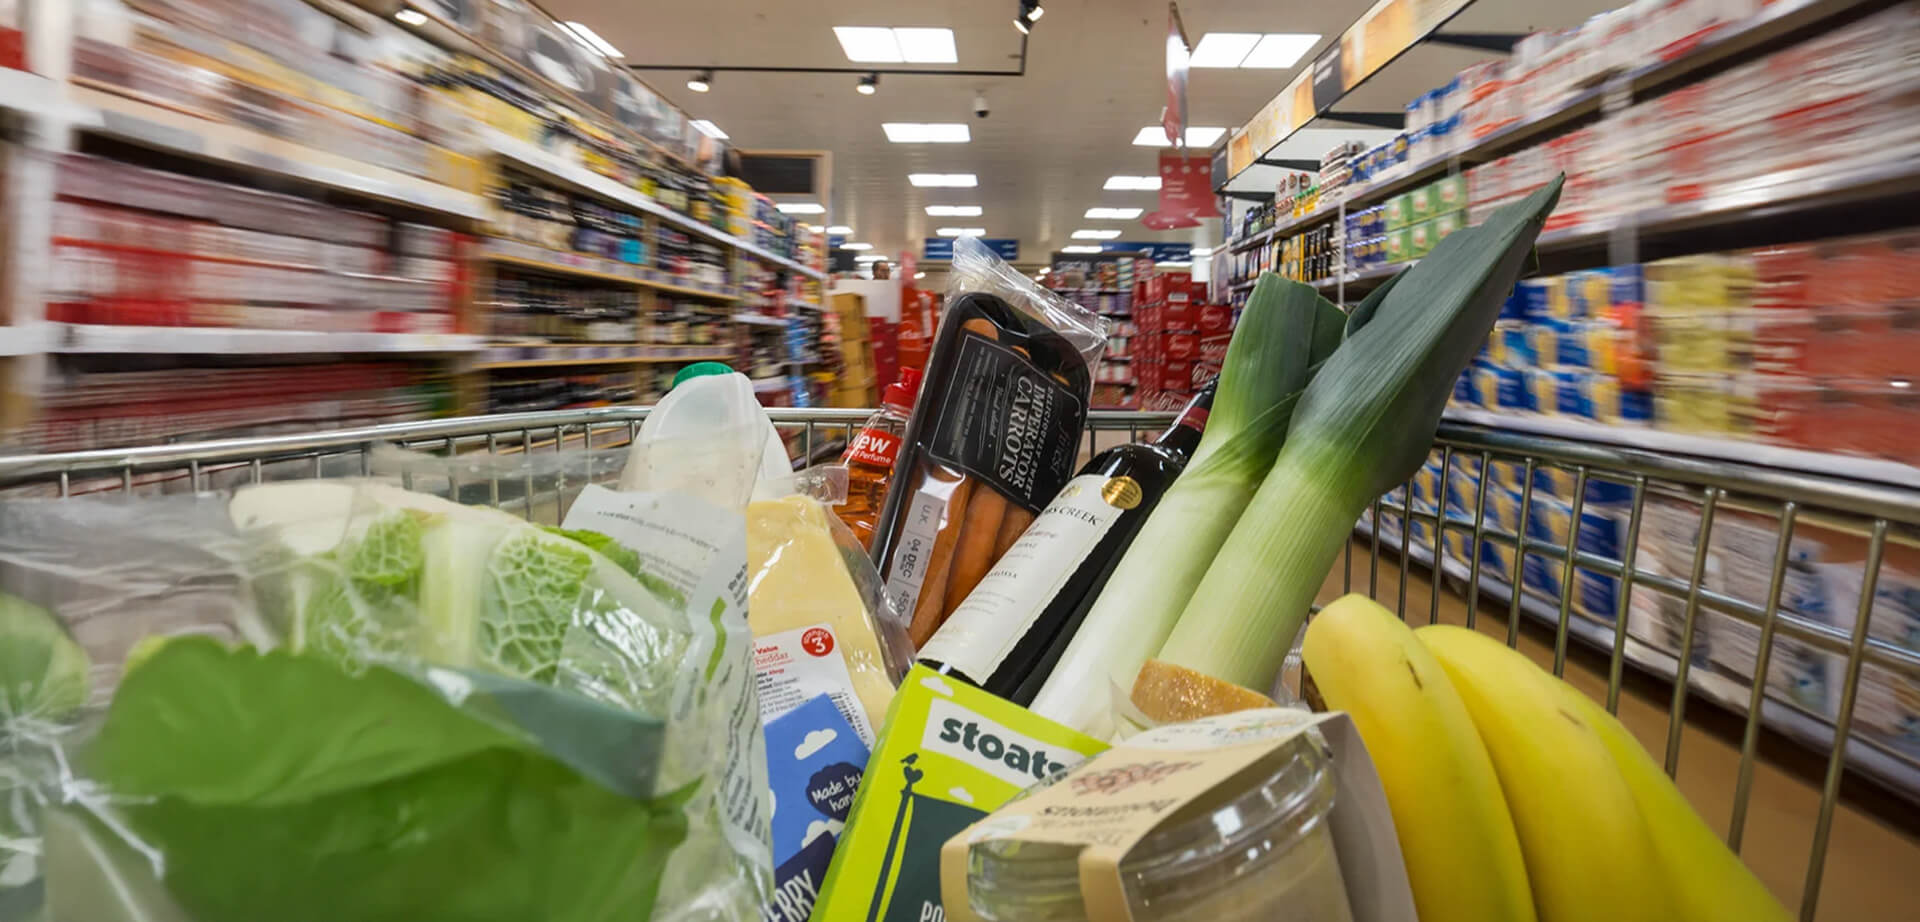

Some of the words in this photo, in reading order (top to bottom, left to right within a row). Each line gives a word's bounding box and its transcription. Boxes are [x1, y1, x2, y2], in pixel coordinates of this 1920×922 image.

[1000, 376, 1032, 483] CARROTS
[1013, 384, 1046, 488] IMPERATOR
[860, 450, 892, 463] Perfume
[1024, 462, 1039, 500] SWEET
[1059, 506, 1096, 526] CREEK
[909, 538, 922, 553] 04
[902, 554, 918, 579] DEC
[756, 645, 778, 655] Value
[811, 636, 826, 653] 3
[754, 653, 788, 665] heddar
[939, 718, 1068, 786] stoats
[811, 780, 844, 804] Made
[844, 772, 861, 788] by
